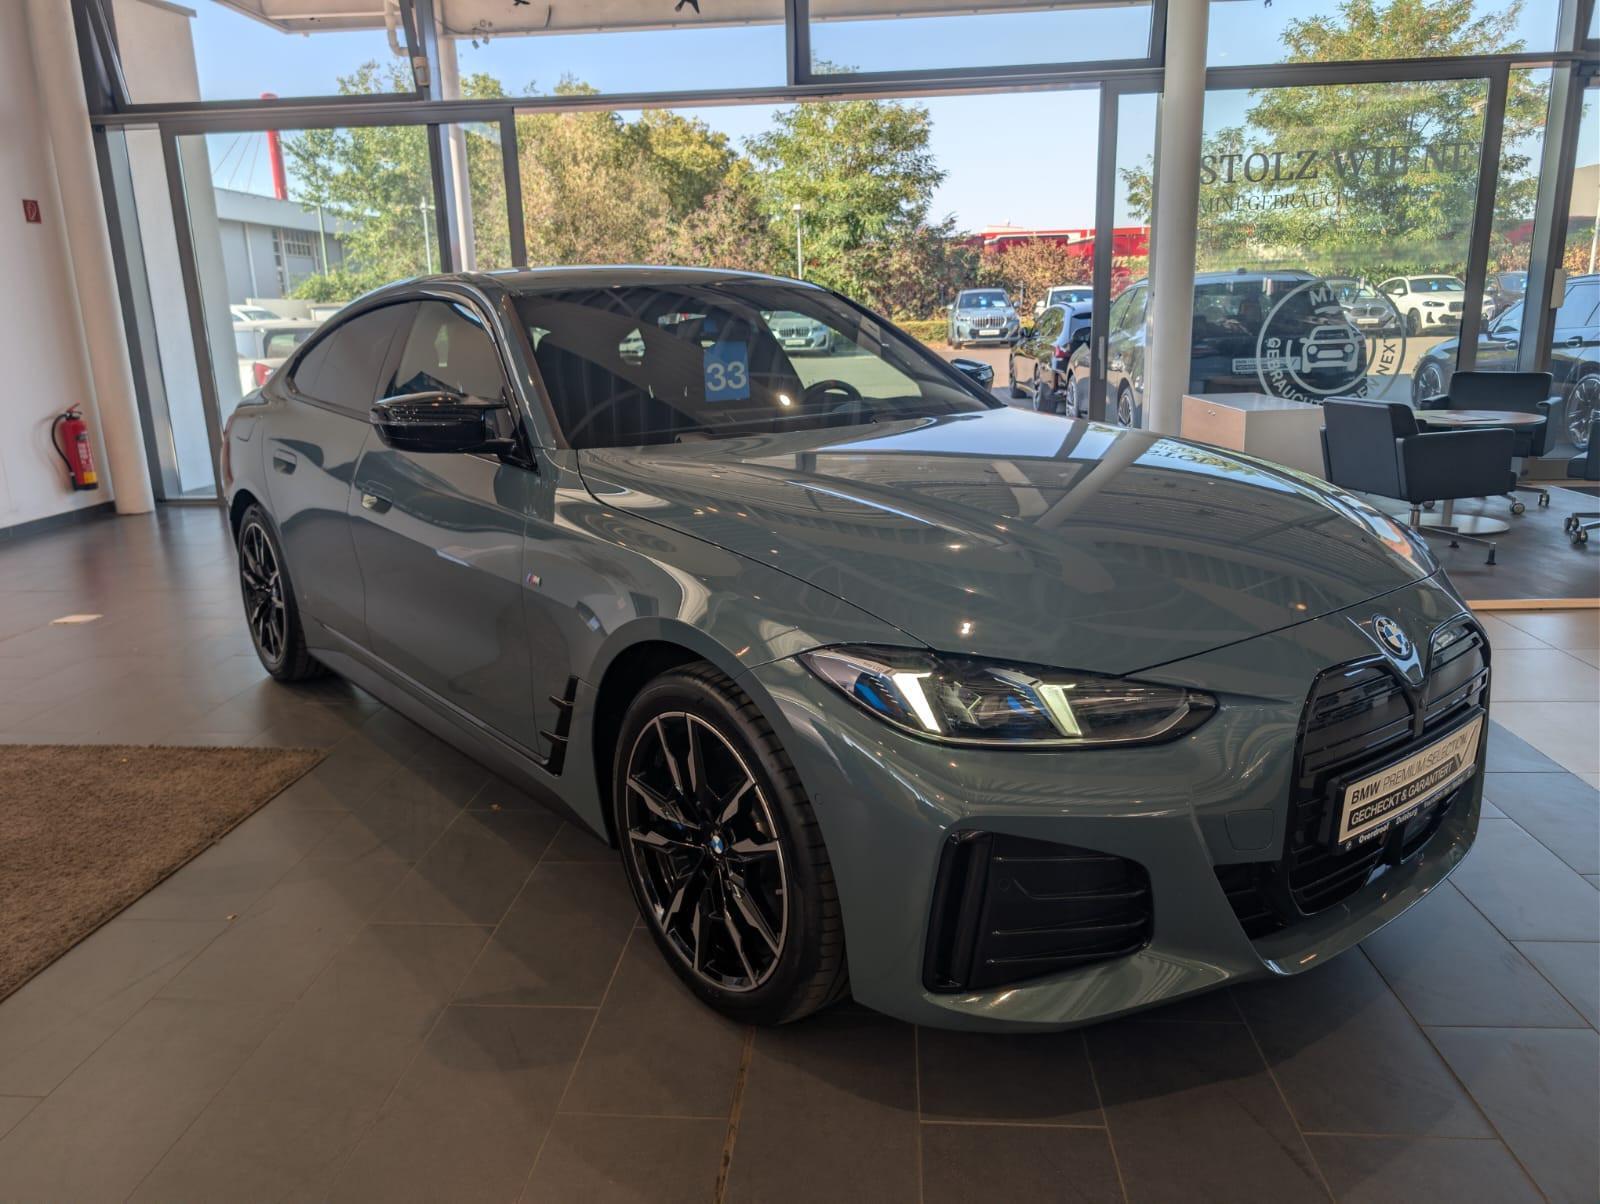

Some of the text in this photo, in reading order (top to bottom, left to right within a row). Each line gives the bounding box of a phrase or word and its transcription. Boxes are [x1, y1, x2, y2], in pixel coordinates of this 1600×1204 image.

[1200, 141, 1477, 185] STOLZ WIE NE
[706, 360, 747, 392] 33
[1351, 734, 1468, 804] BMW PREMIUM SELECTION
[1351, 792, 1400, 825] GECHECKT
[1400, 789, 1408, 802] &
[1408, 762, 1454, 796] GARANTIERT
